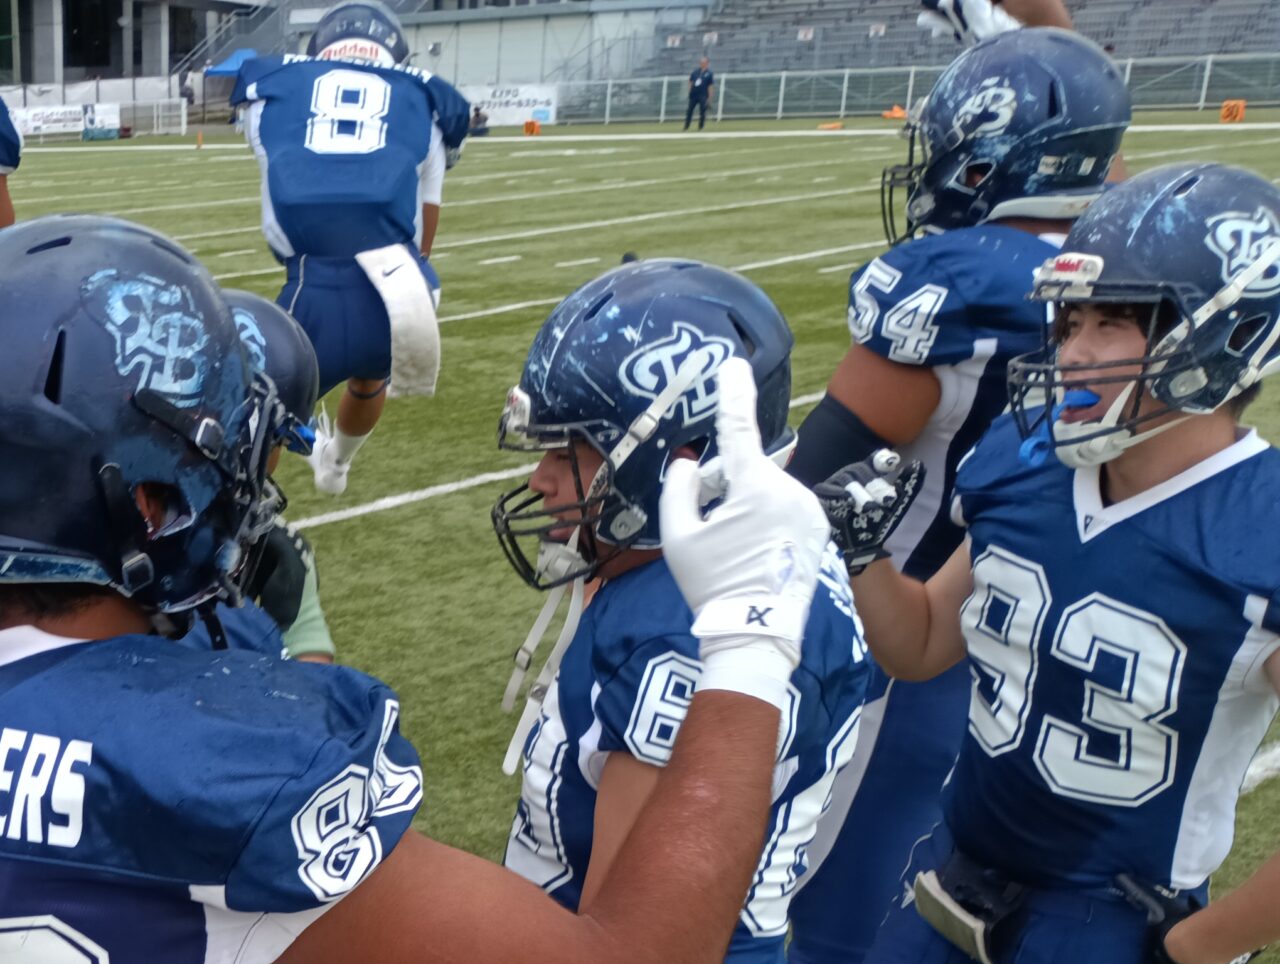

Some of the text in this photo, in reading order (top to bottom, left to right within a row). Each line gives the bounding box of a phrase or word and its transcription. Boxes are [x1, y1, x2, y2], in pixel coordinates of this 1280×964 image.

[304, 69, 392, 154] 8
[844, 256, 949, 365] 54
[958, 543, 1190, 809] 93
